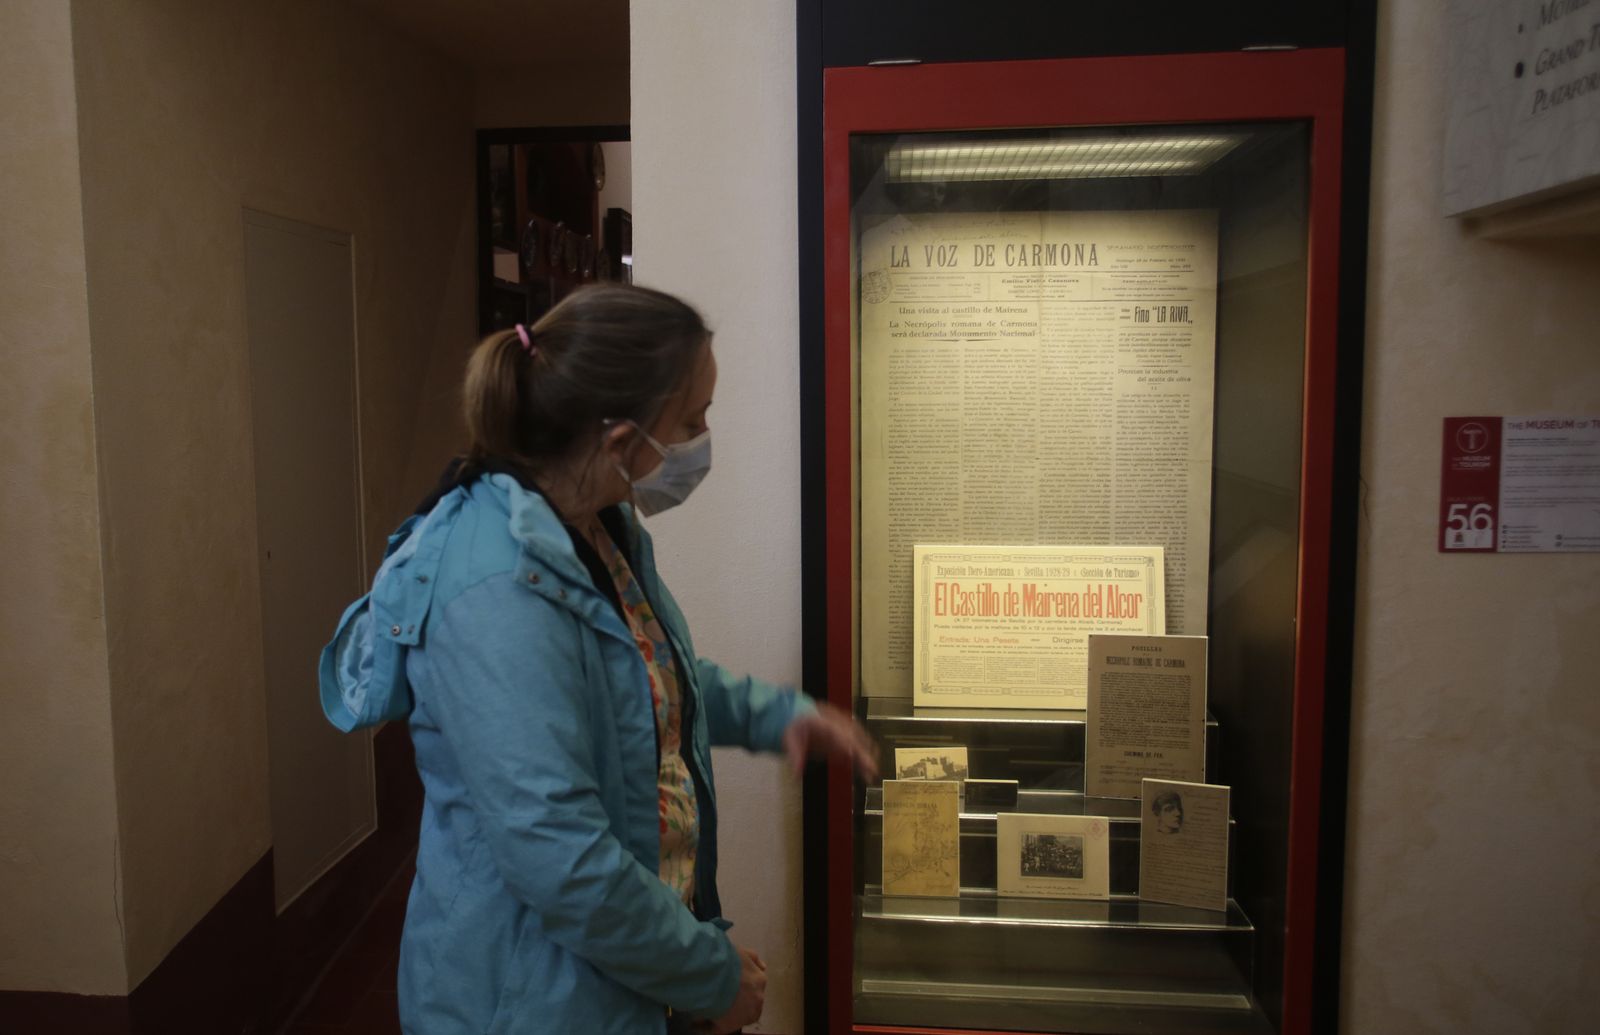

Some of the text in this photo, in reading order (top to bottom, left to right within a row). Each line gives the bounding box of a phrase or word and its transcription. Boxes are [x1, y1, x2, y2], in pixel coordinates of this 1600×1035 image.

[890, 243, 1099, 268] LA VOZ DE CARMONA
[899, 307, 916, 315] Una
[952, 306, 981, 314] castillo
[982, 306, 993, 314] de
[995, 306, 1028, 314] Mairena
[889, 320, 899, 328] La
[986, 320, 997, 328] de
[910, 330, 946, 338] declarada
[1526, 420, 1574, 430] MUSEUM
[1447, 503, 1493, 531] 56
[1024, 566, 1044, 577] Sevilla
[934, 582, 1143, 619] El Castillo de Mairena del Alcor
